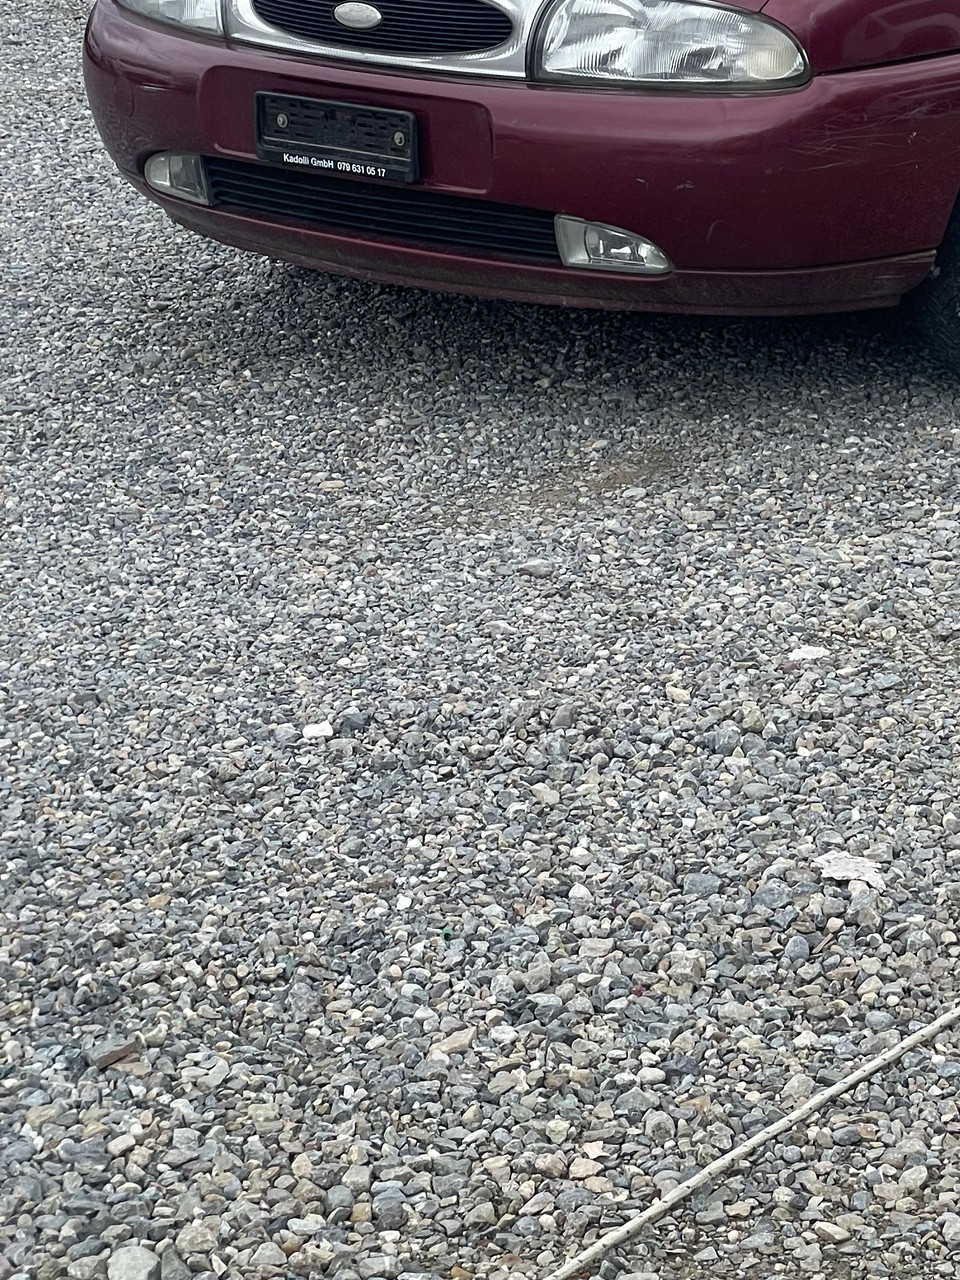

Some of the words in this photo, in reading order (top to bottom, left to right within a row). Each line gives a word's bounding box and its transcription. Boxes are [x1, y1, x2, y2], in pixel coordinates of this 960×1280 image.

[310, 158, 334, 169] GmbH
[337, 162, 351, 172] 079
[351, 164, 364, 174] 631
[366, 167, 376, 176] 05
[377, 168, 386, 177] 17
